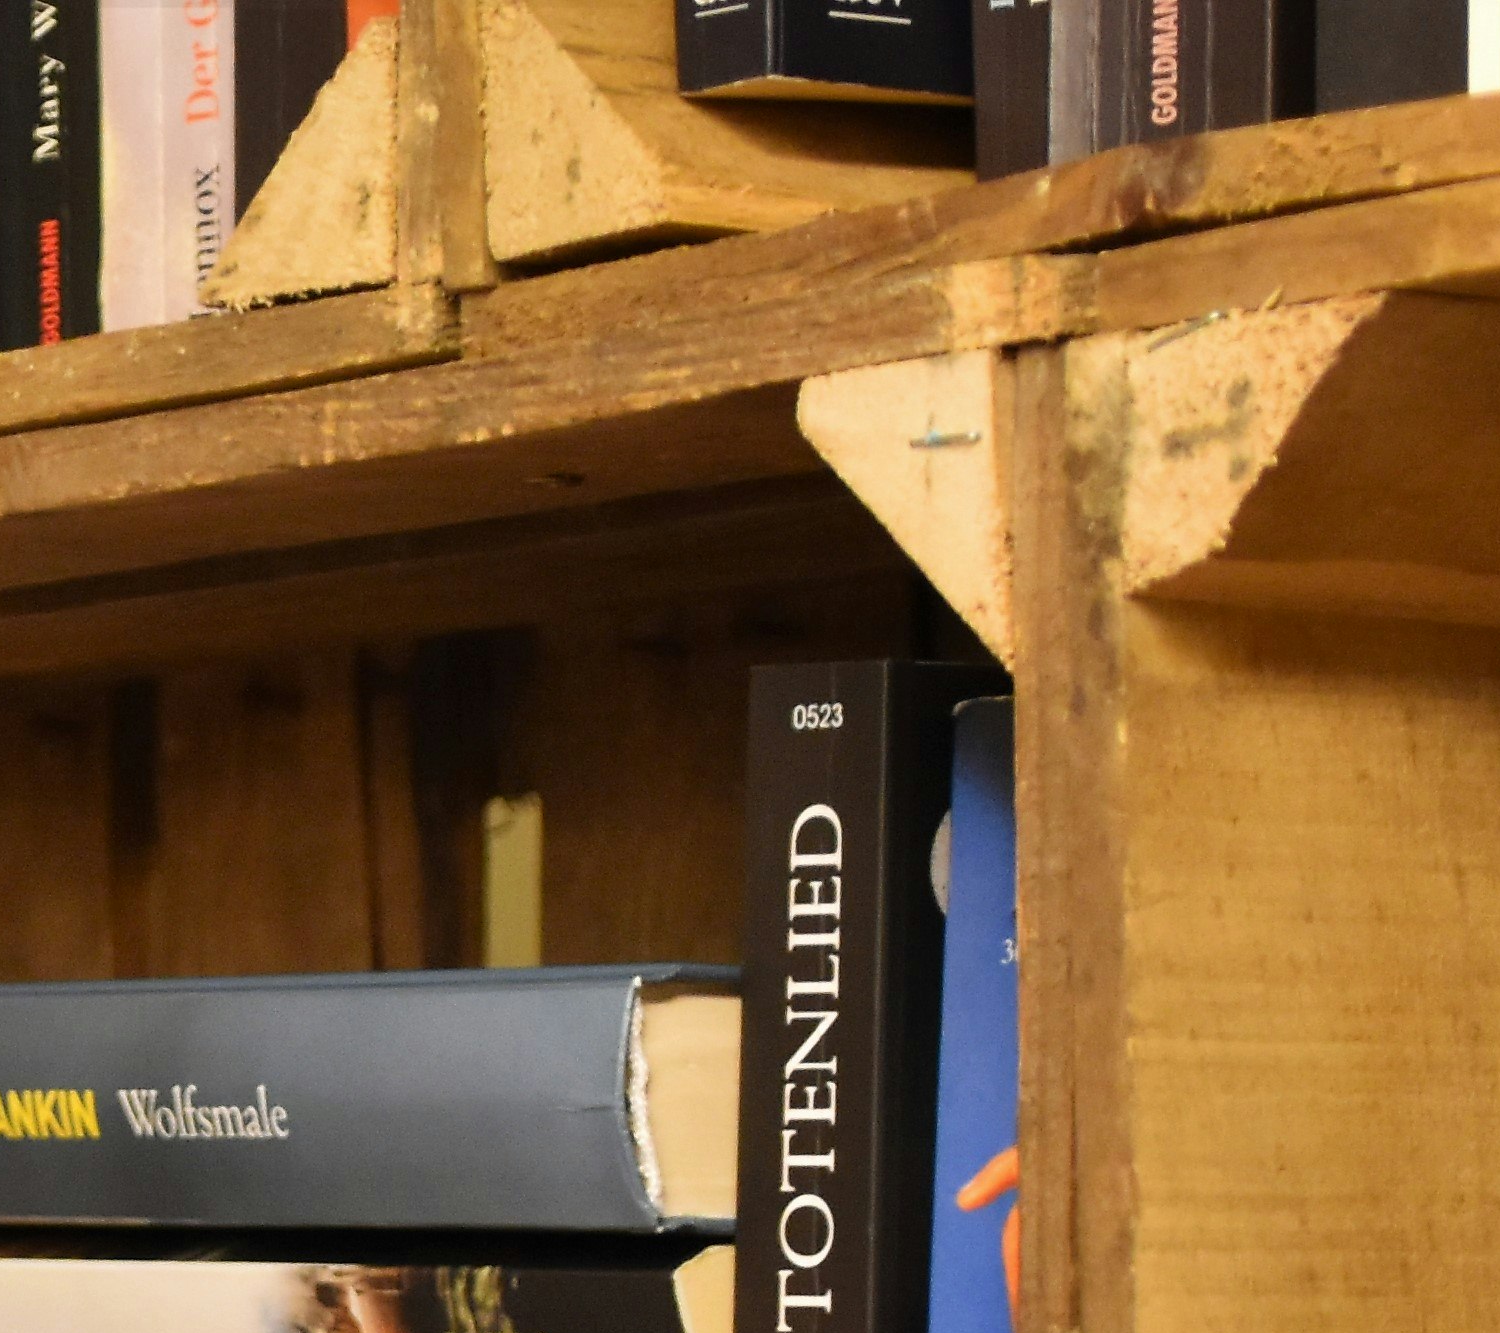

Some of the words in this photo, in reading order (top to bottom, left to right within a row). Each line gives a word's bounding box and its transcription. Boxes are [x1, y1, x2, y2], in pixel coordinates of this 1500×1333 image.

[32, 54, 68, 161] Mary
[792, 702, 844, 731] 0523
[776, 802, 843, 1333] TOTENLIED
[119, 1085, 291, 1142] Wolfsmale
